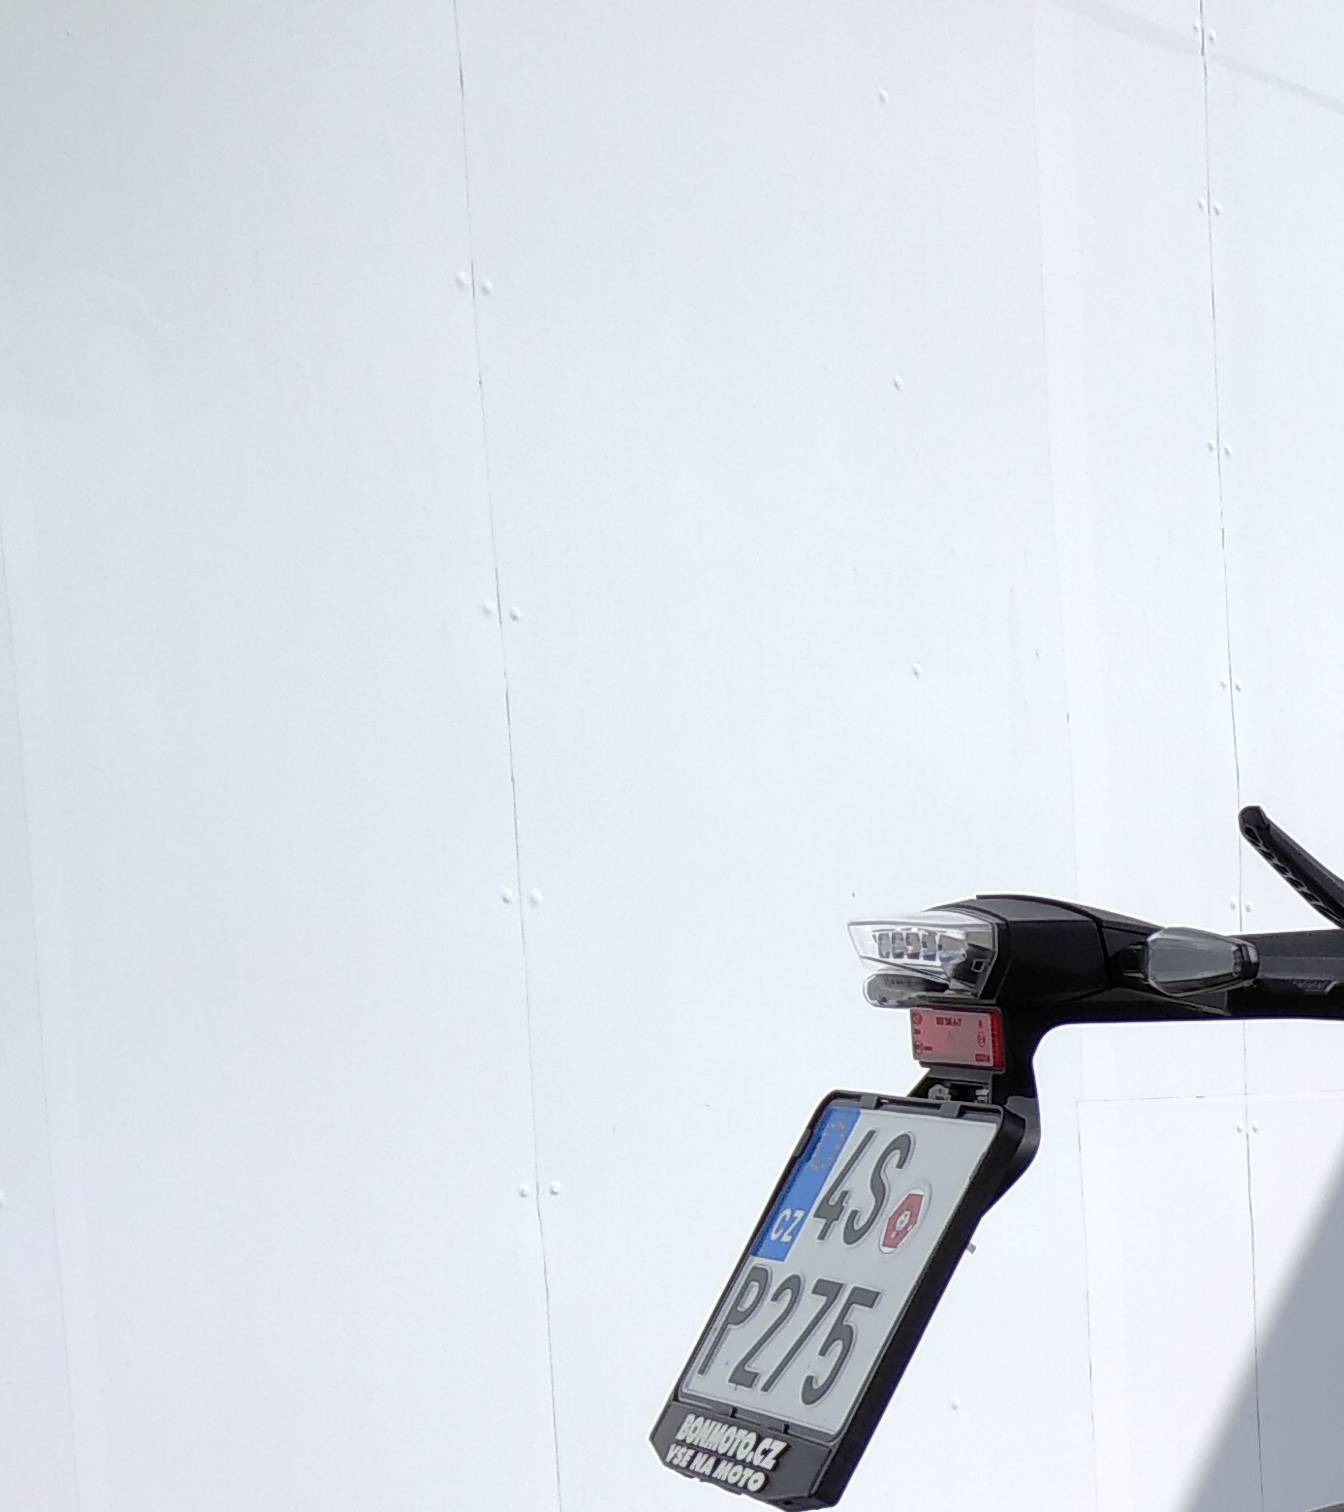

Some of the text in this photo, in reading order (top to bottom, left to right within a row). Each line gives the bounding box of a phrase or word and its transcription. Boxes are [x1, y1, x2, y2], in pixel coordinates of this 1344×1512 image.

[813, 1129, 912, 1246] 4S
[769, 1209, 805, 1243] CZ
[697, 1265, 882, 1405] P275
[675, 1413, 787, 1470] BONMOTO.CZ
[689, 1453, 716, 1475] NA
[712, 1460, 765, 1492] MOTO
